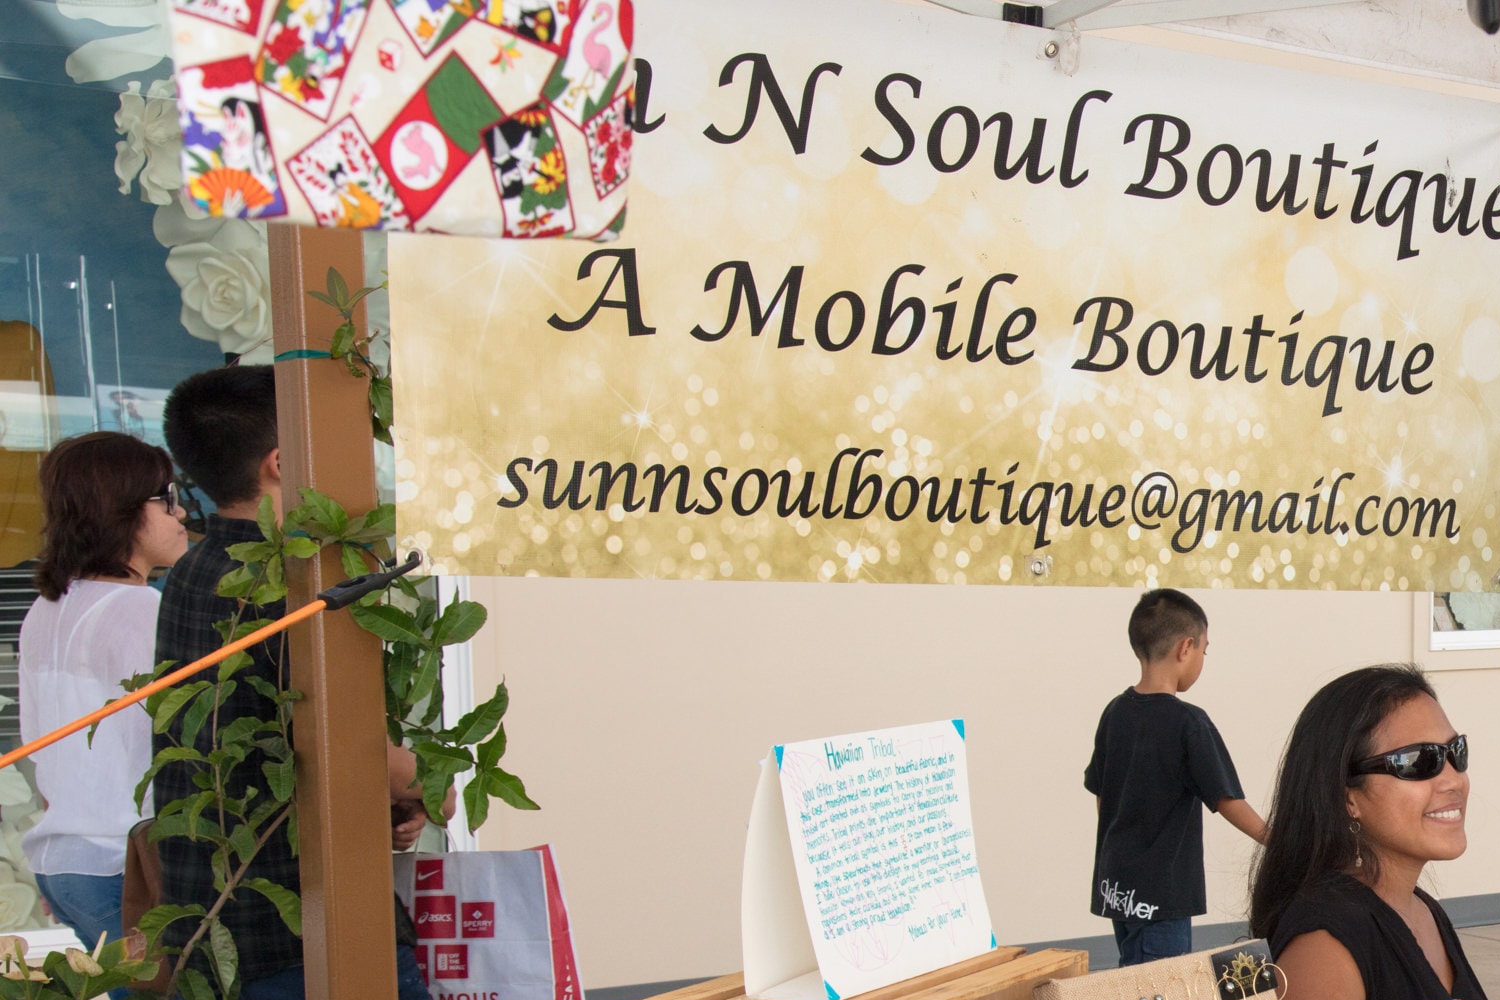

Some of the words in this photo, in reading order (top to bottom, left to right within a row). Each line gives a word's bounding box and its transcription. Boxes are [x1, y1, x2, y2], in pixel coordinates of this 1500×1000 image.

[703, 53, 842, 157] N
[861, 73, 1113, 190] Soul
[547, 248, 656, 338] A
[690, 260, 1038, 366] Mobile
[1071, 297, 1434, 417] Boutique
[497, 447, 1461, 554] sunnsoulboutique@gmail.com
[824, 742, 863, 770] Hawaiian
[463, 920, 492, 928] SPERRY
